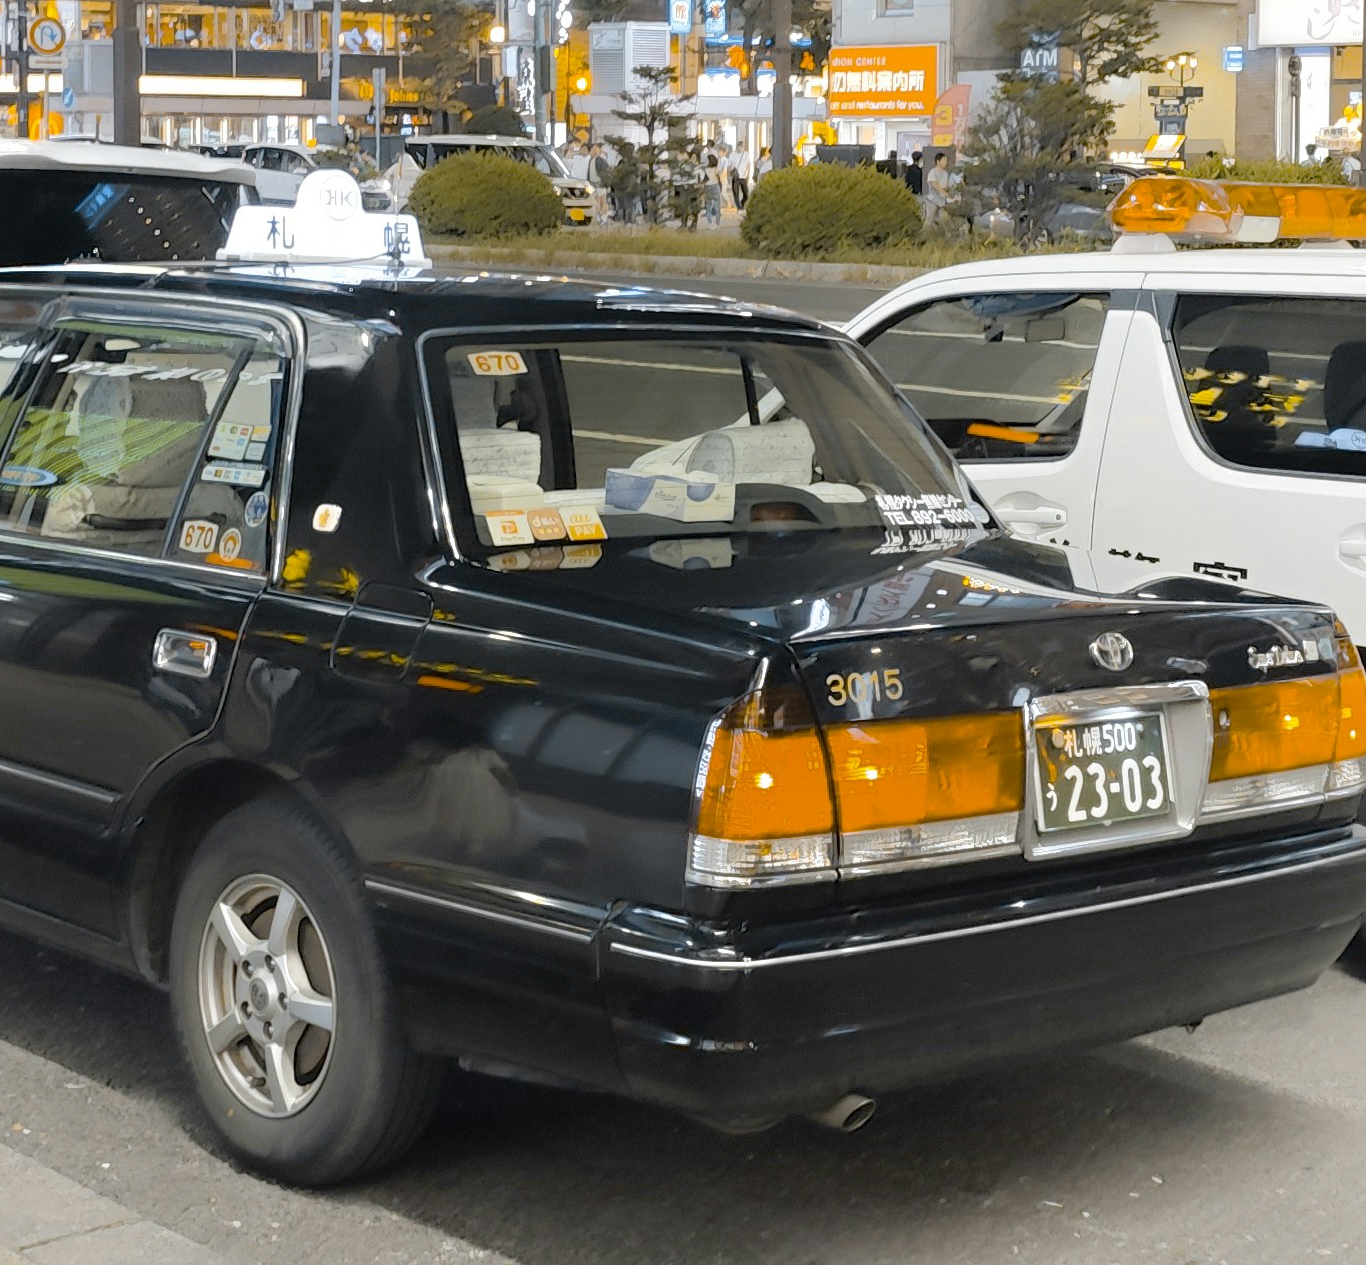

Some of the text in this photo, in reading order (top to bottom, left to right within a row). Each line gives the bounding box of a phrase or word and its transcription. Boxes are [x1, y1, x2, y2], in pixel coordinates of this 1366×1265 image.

[1023, 49, 1058, 67] ATM
[474, 353, 521, 373] 670
[883, 511, 915, 526] TEL
[184, 524, 215, 550] 670
[826, 668, 903, 707] 3015
[1063, 721, 1137, 759] 札幌500
[1064, 755, 1164, 823] 23-03
